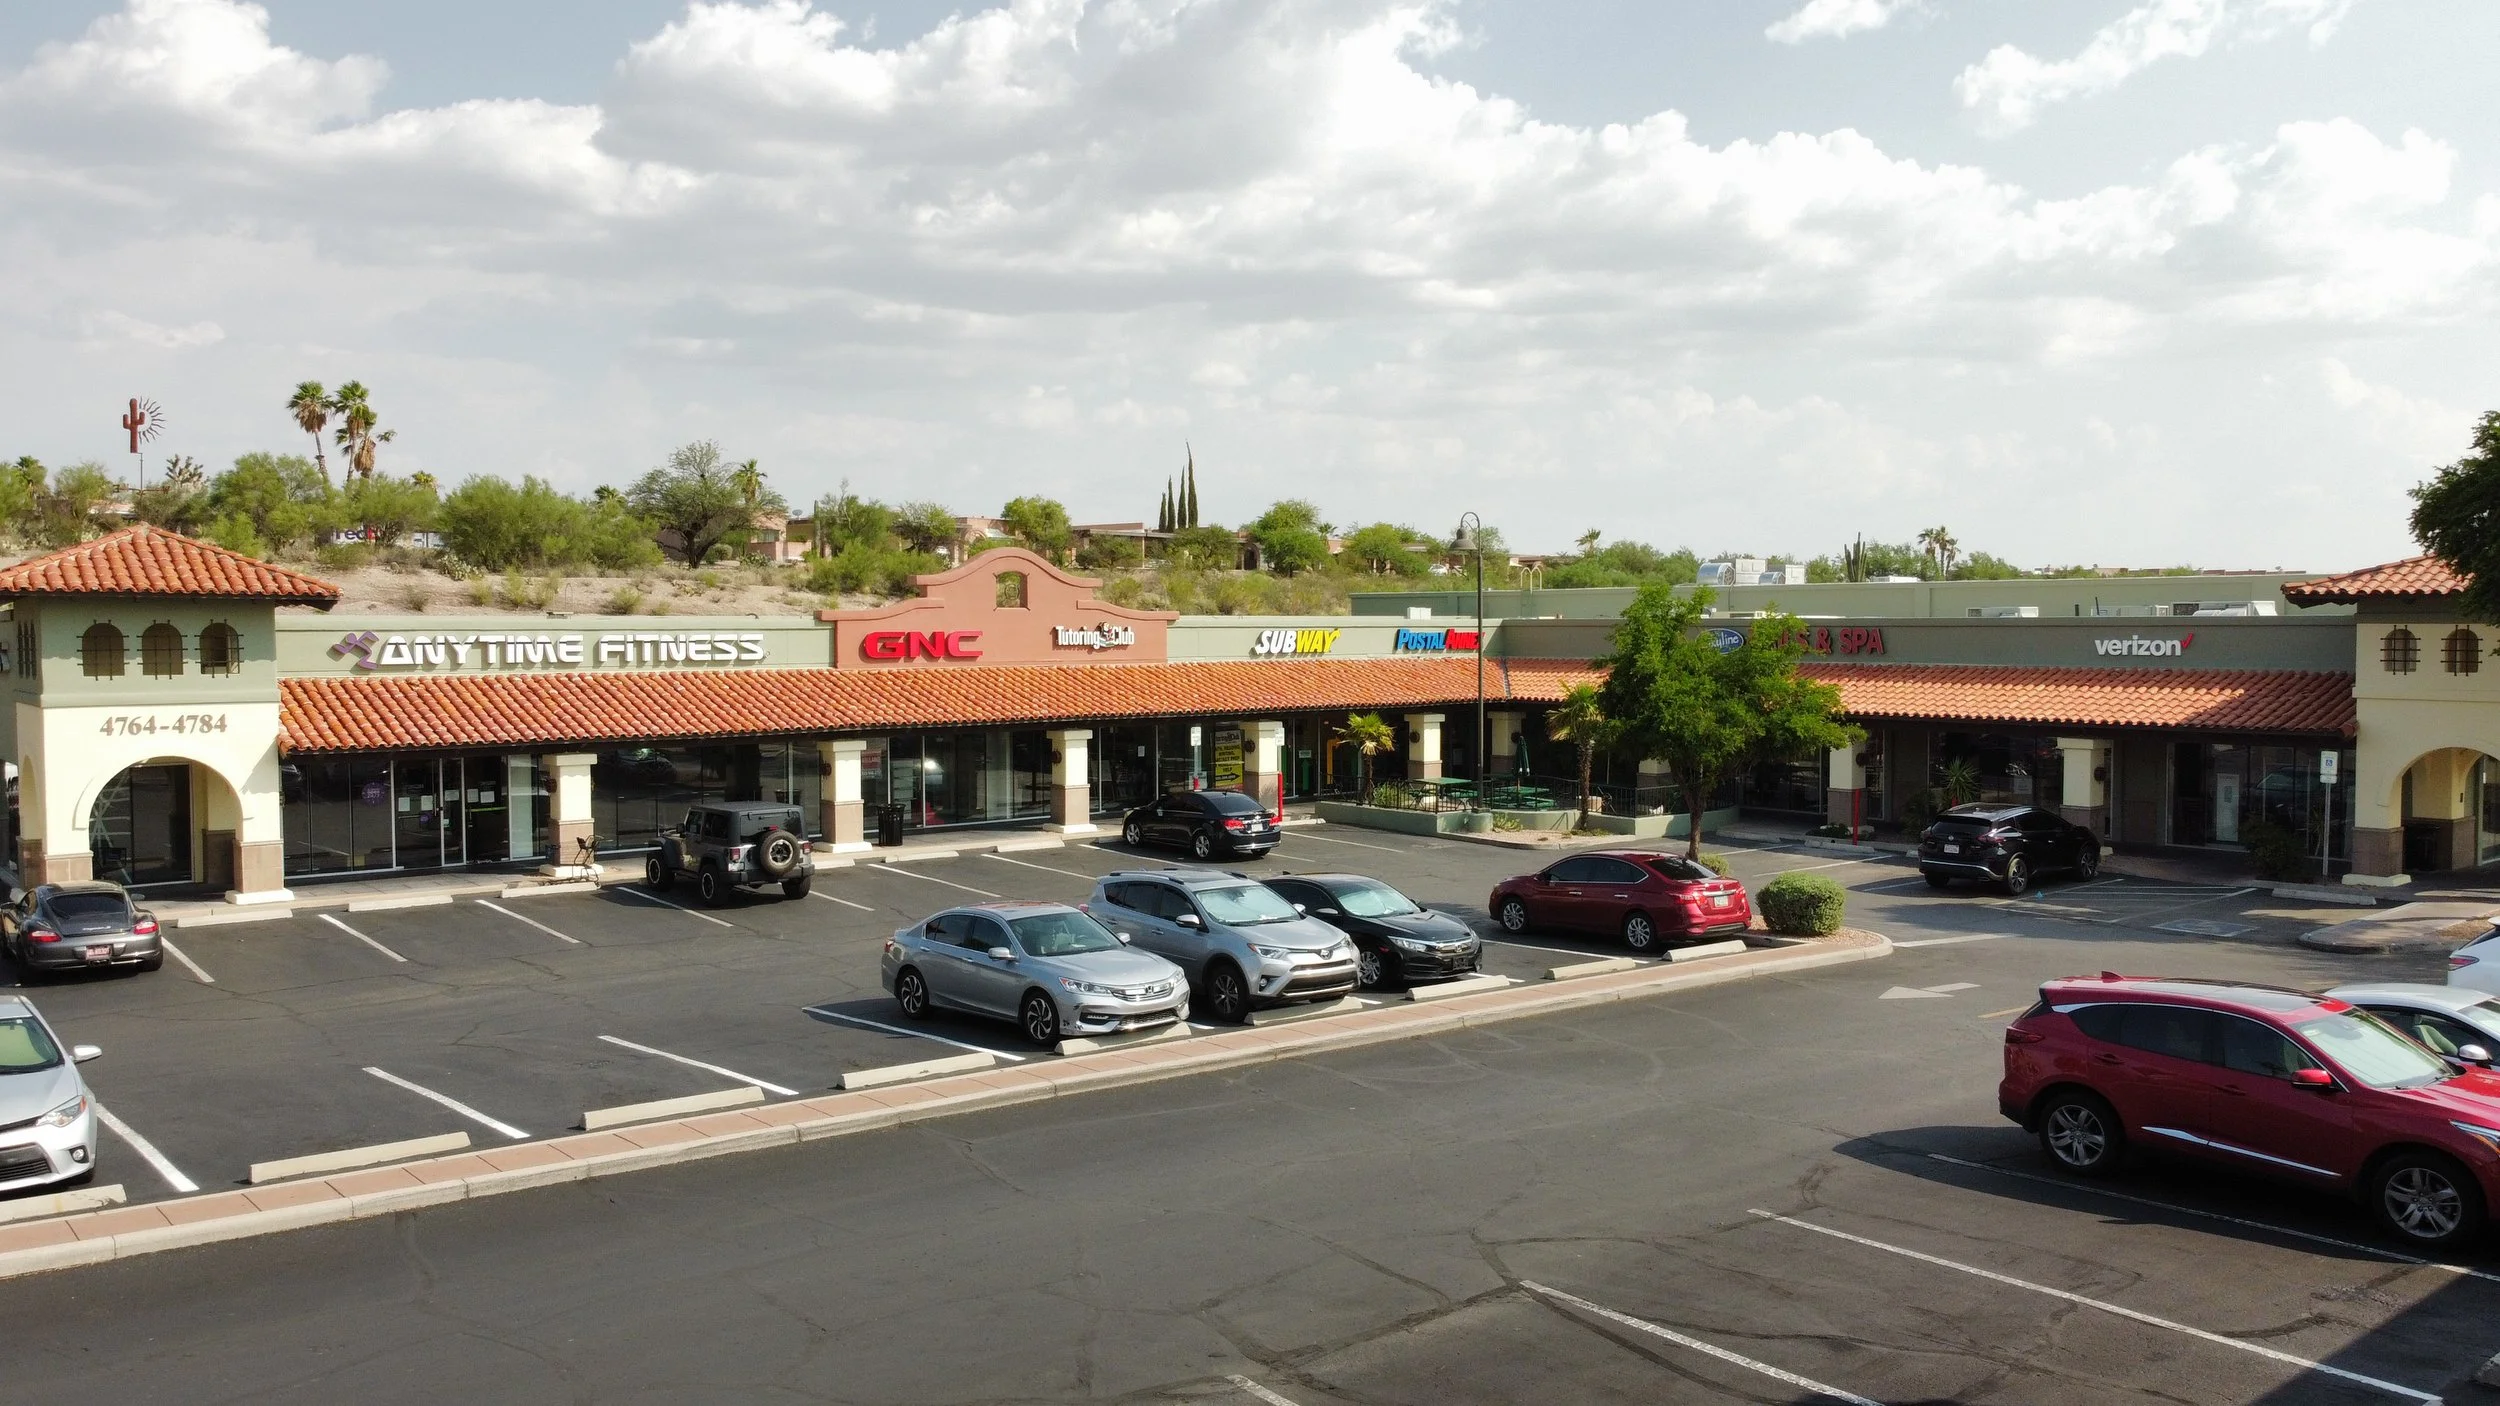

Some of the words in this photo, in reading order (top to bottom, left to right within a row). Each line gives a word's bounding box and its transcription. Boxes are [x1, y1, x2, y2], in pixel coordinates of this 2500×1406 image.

[379, 634, 584, 666] ANYTIME
[599, 633, 764, 662] FITNESS
[863, 629, 984, 659] GNC
[1056, 625, 1101, 650] Tutoring
[1111, 625, 1135, 646] Club
[1254, 627, 1341, 655] SUBWAY
[1396, 628, 1485, 651] POSTALANNE
[1708, 629, 1741, 650] yline
[1815, 626, 1832, 655] &
[1839, 627, 1886, 655] SPA
[2094, 634, 2182, 657] verizon
[99, 713, 228, 737] 4764-4784
